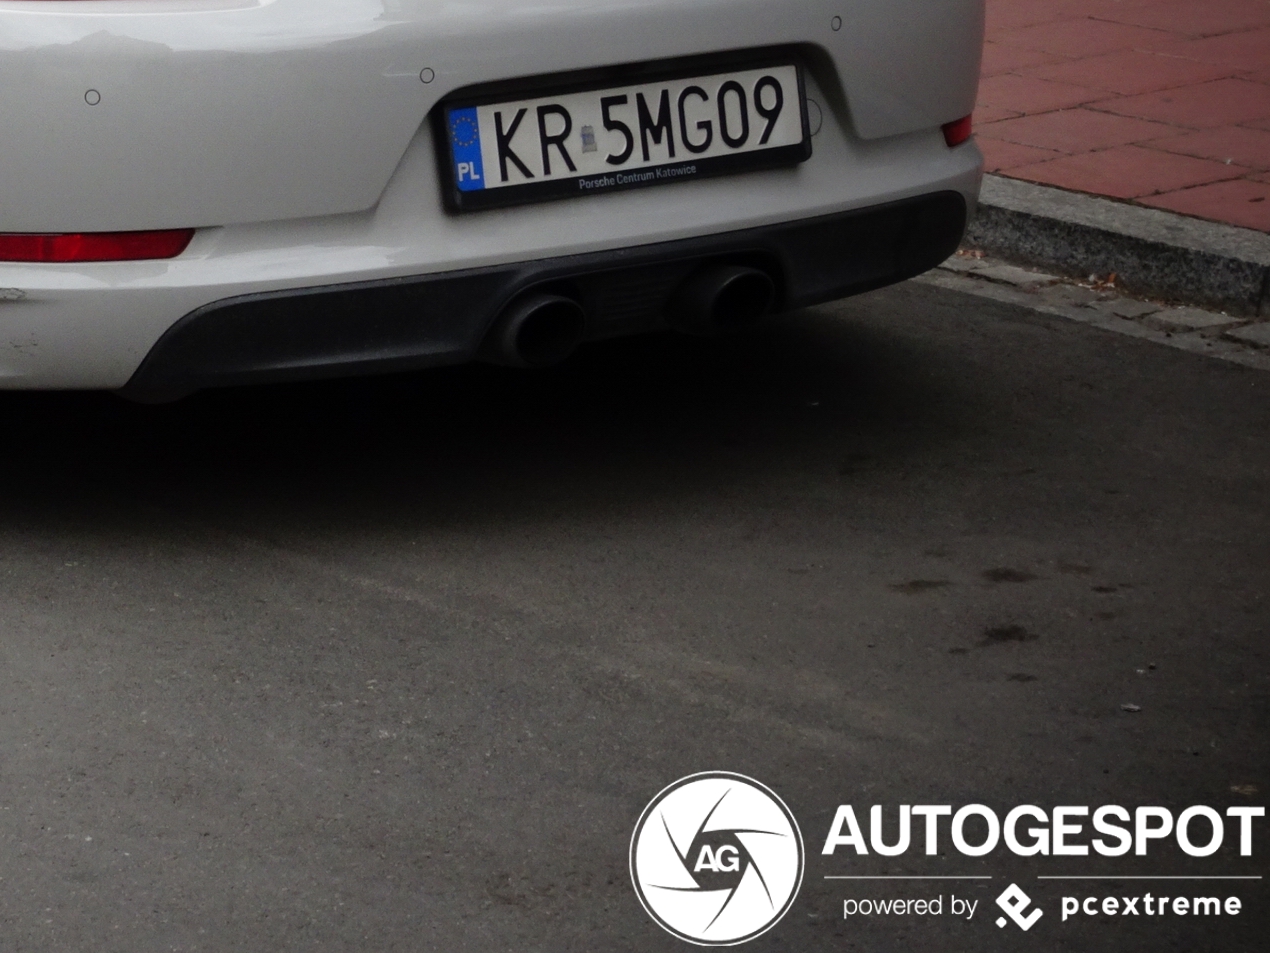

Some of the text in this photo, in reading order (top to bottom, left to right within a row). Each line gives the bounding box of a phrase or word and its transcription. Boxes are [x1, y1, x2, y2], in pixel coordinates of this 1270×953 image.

[493, 75, 784, 182] KR 5MG09
[457, 162, 480, 182] PL
[578, 164, 697, 190] Porsche Centrum Katowice
